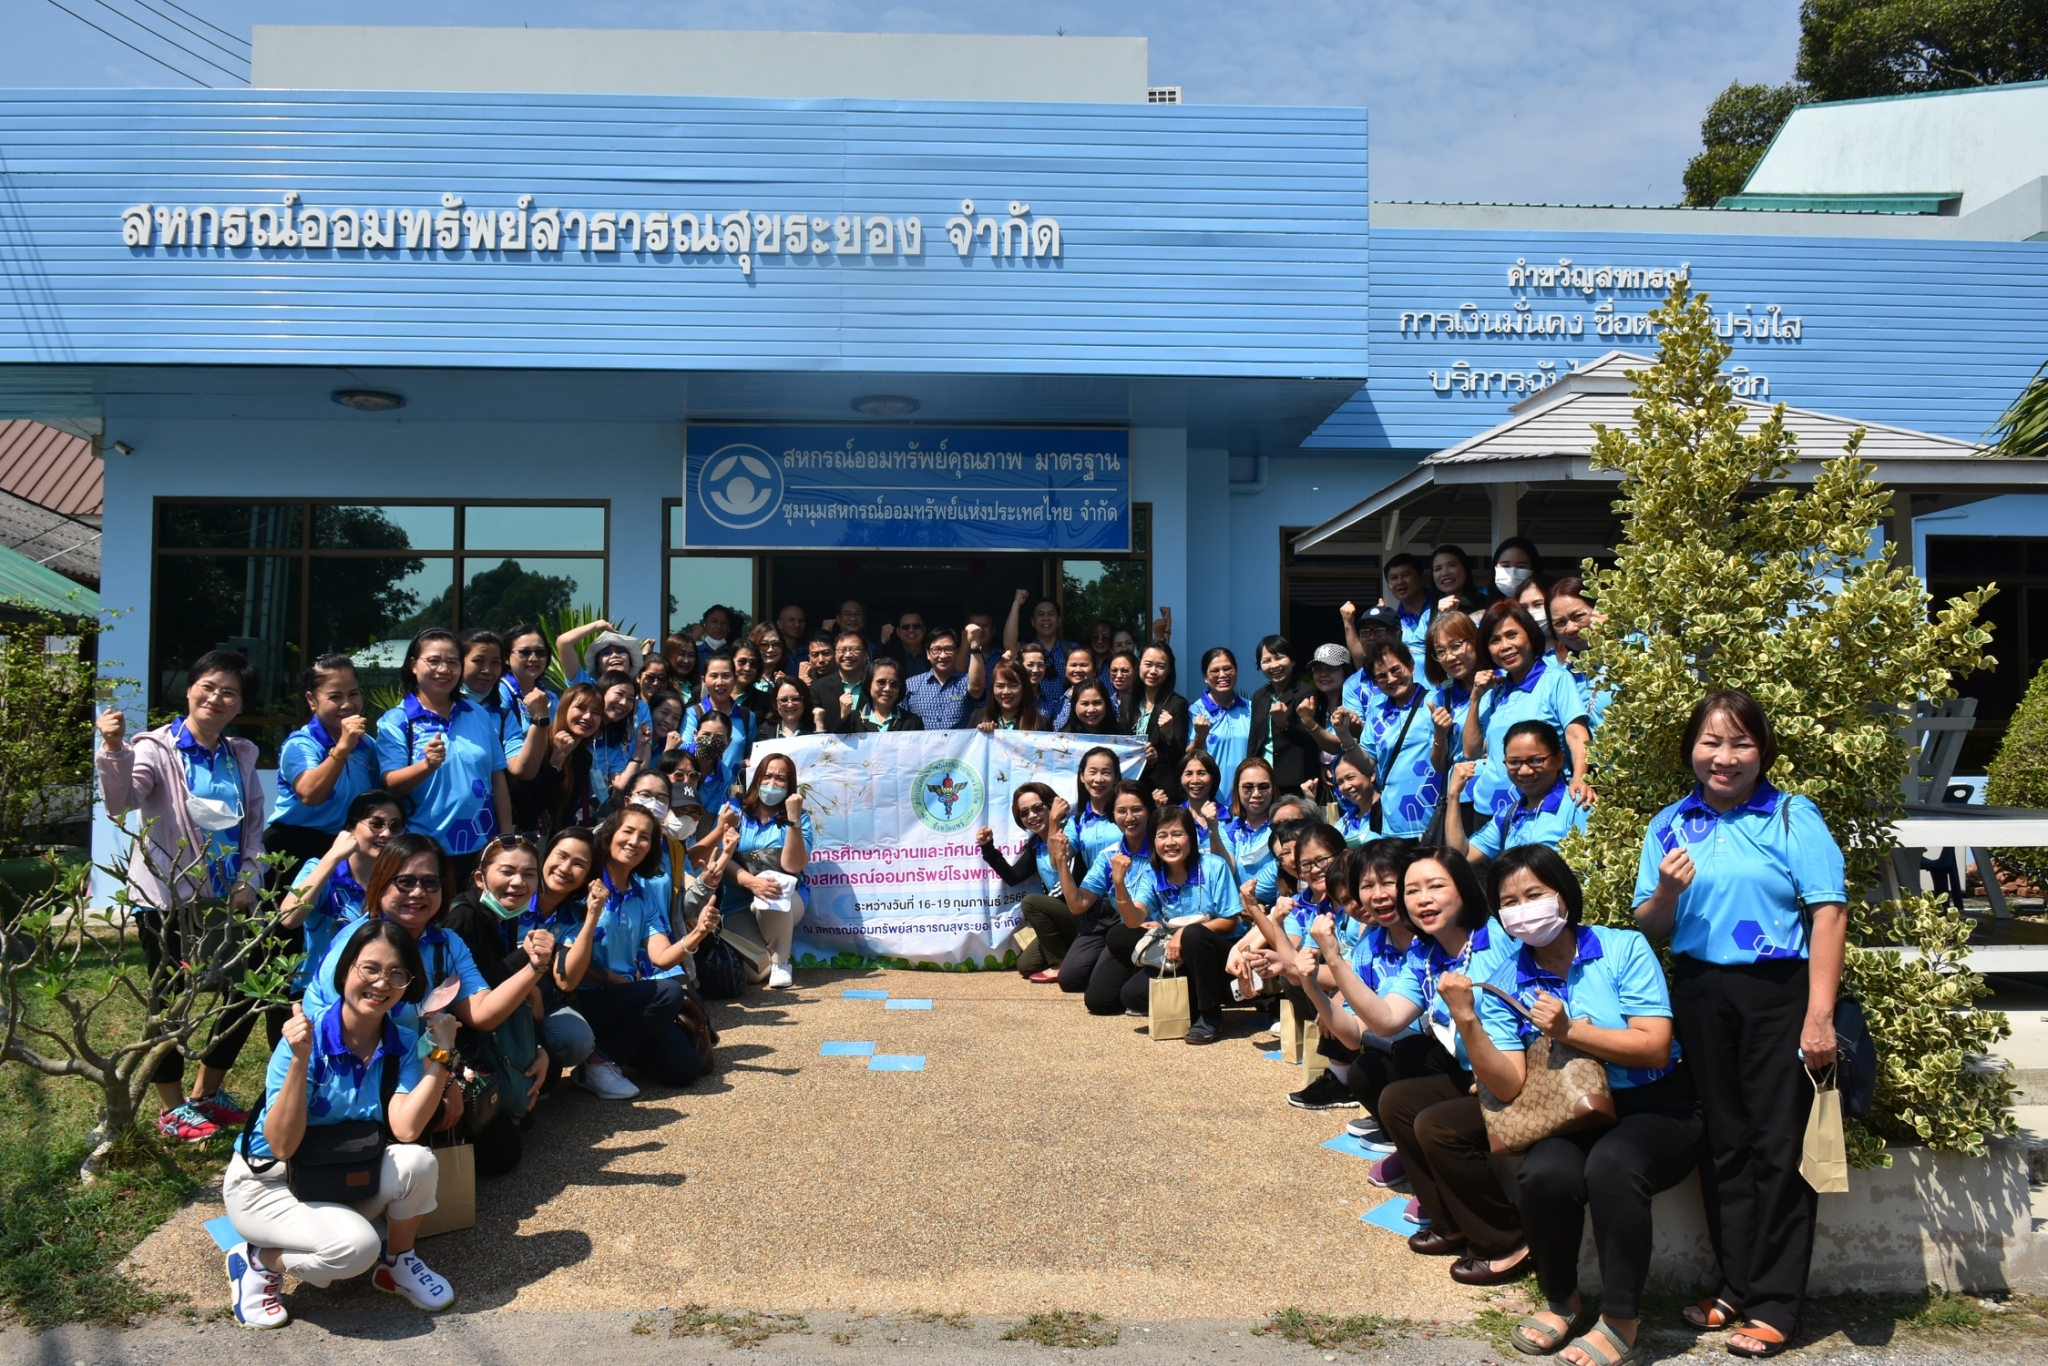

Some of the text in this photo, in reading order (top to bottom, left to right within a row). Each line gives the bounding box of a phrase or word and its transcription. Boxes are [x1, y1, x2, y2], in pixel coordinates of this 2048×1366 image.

[122, 191, 1063, 276] สหกรณ์ออมทรัพย์สาธารณสุขระยอง จำกัด
[1507, 257, 1692, 295] คำขวัญสหกรณ์
[1399, 295, 1585, 336] การเงินมั่นคง
[783, 438, 1121, 481] สหกรณ์ออมทรัพย์คุณภาพ มาตรฐาน
[782, 494, 1119, 528] ชุมนุมสหกรณ์ออมทรัพย์แห่งประเทศไทย จำกัด
[854, 895, 914, 912] ระหว่างวันที่
[918, 899, 951, 910] 16-19
[815, 921, 991, 937] สหกรณ์ออมทรัพย์สาธารณสุขระยอ
